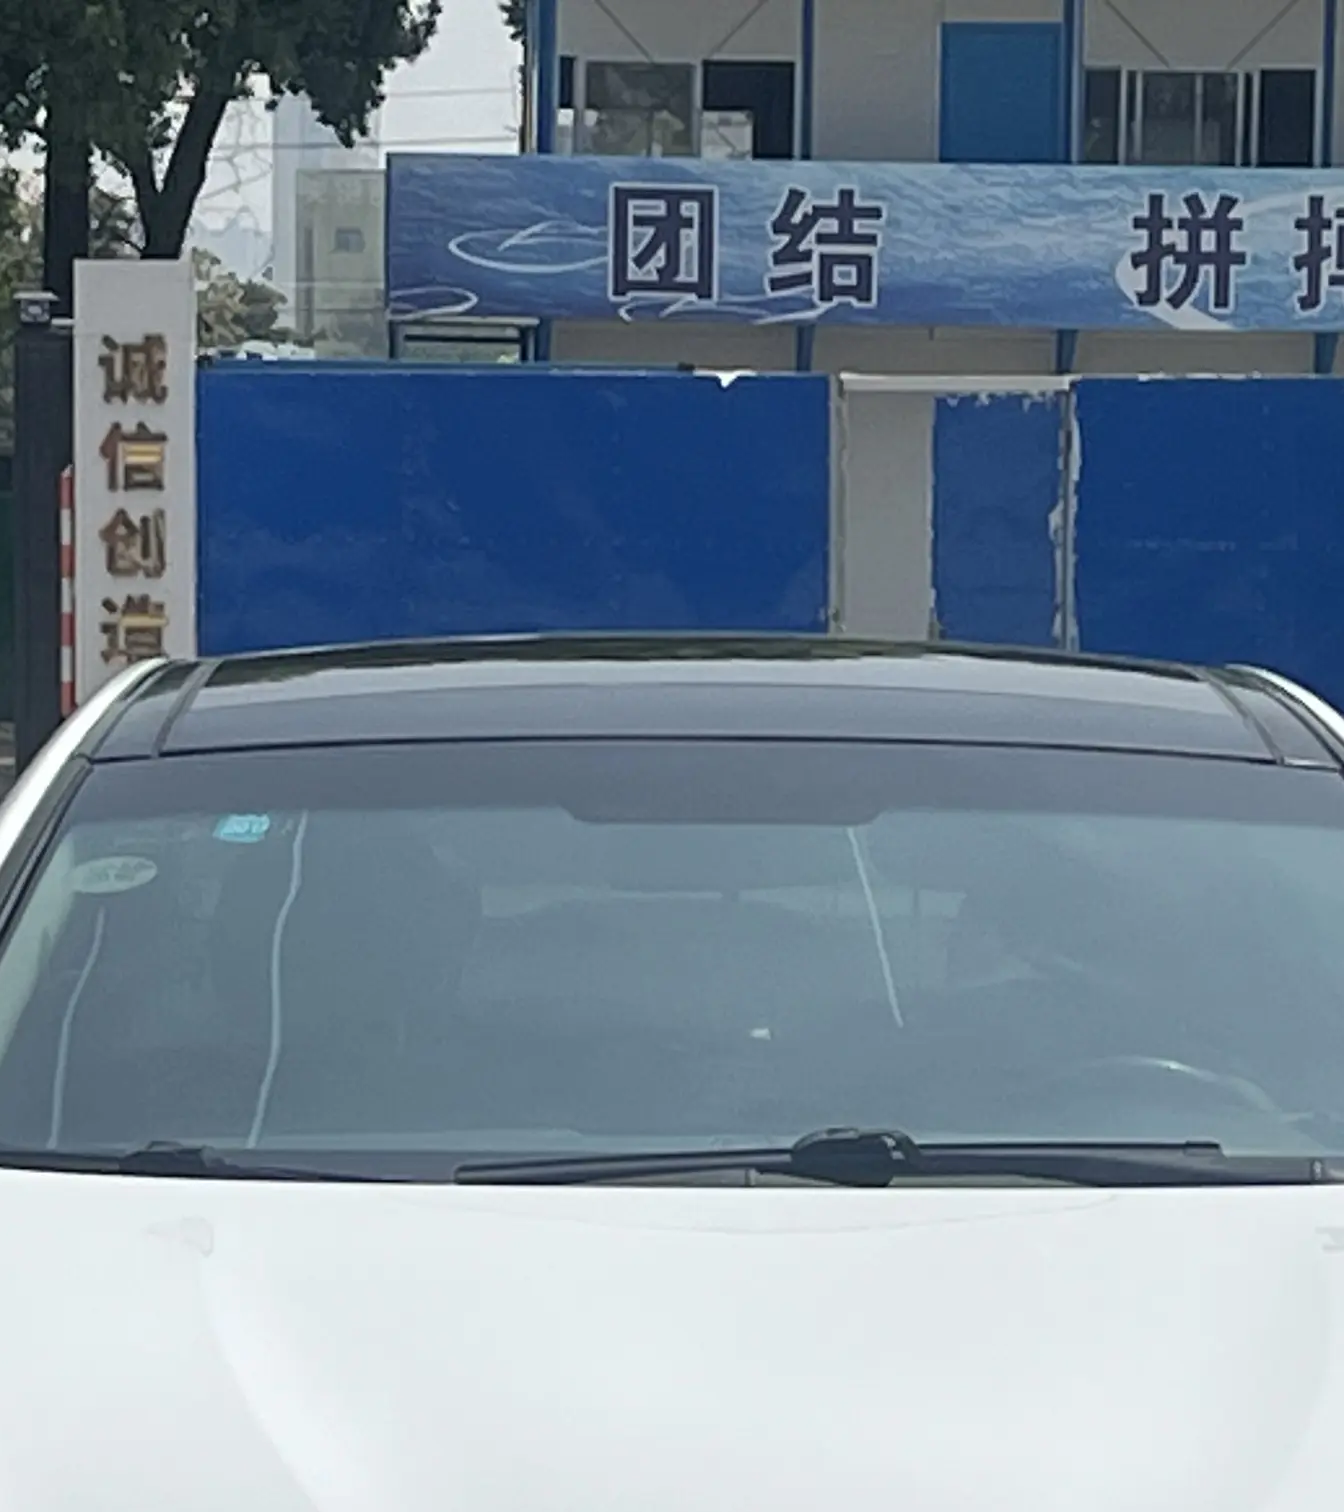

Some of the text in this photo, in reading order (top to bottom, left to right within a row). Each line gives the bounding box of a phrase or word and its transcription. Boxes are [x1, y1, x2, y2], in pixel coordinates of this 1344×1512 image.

[609, 185, 883, 305] 团结
[98, 334, 169, 664] 诚信创造
